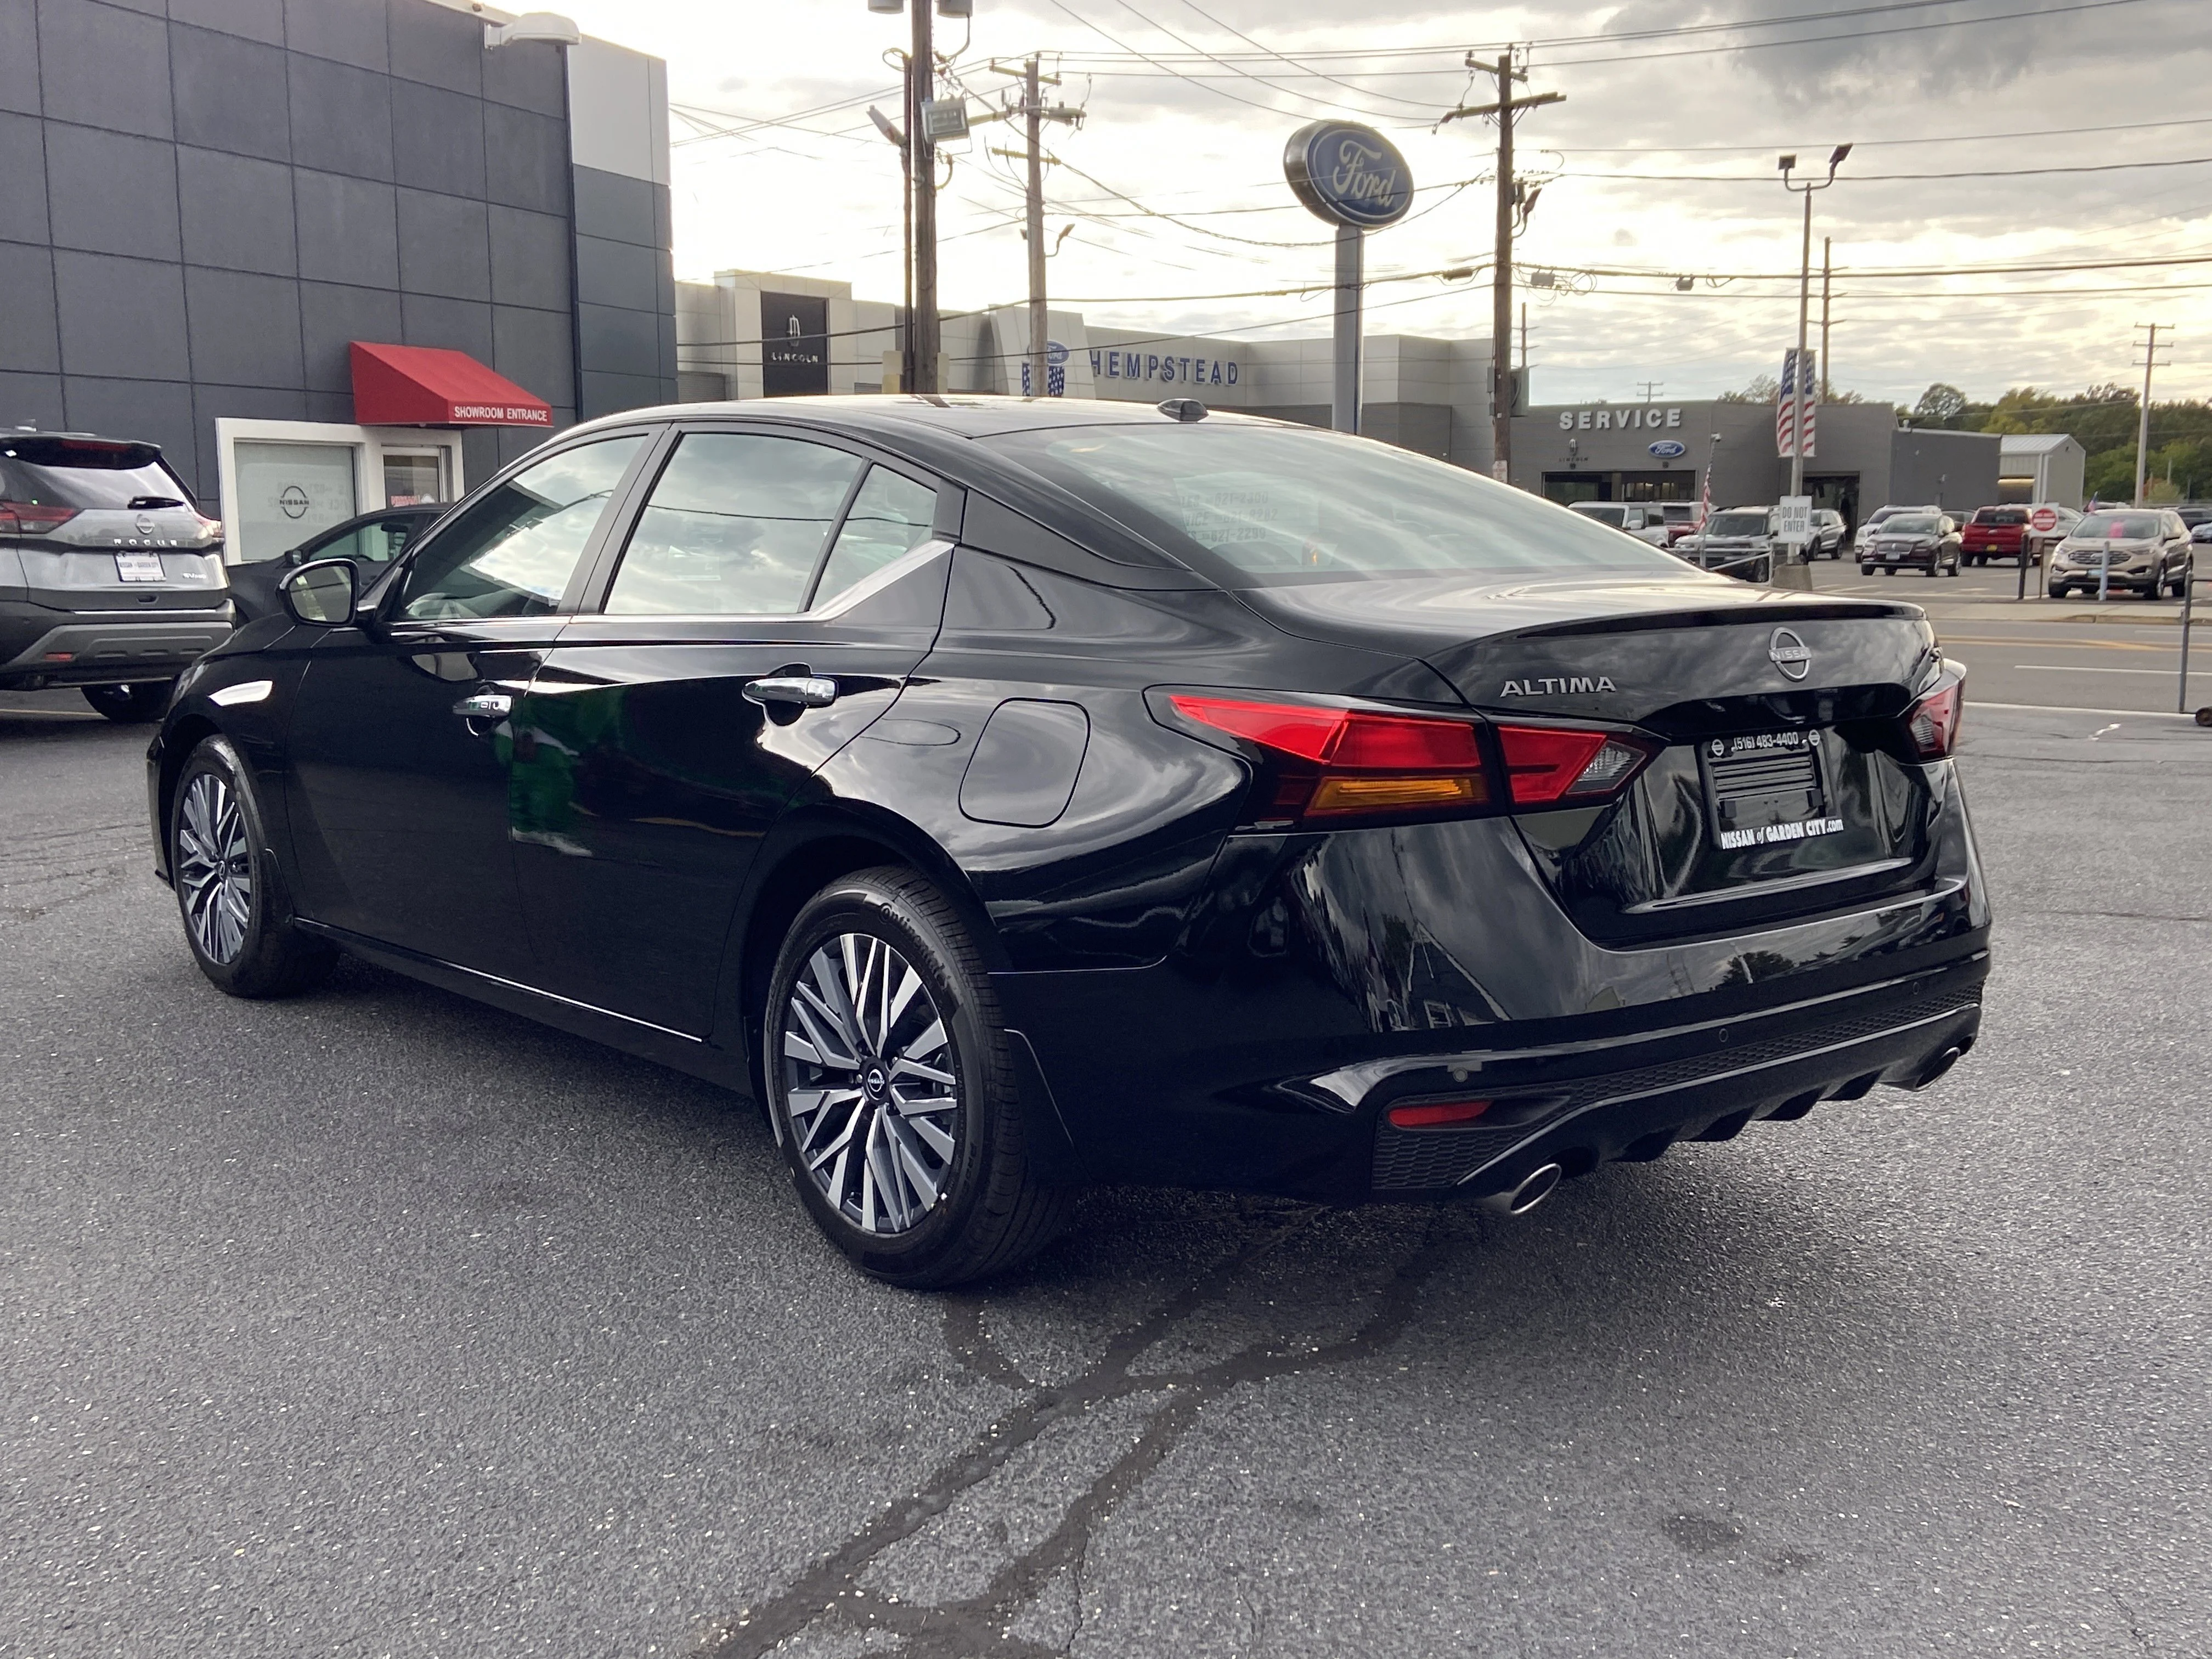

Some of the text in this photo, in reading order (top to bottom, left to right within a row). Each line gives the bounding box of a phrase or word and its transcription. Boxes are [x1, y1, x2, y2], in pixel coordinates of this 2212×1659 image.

[1332, 139, 1396, 207] Ford
[771, 352, 819, 363] LINCOLN
[1090, 349, 1238, 385] HEMPSTEAD
[454, 406, 548, 422] SHOWROOM ENTRANCE
[1559, 408, 1682, 430] SERVICE
[1655, 444, 1678, 454] Ford
[1782, 506, 1808, 518] DO NOT
[1784, 520, 1805, 532] ENTER
[1770, 649, 1810, 661] NISSA
[1499, 676, 1617, 697] ALTIMA
[1734, 736, 1756, 750] (516)
[1756, 732, 1799, 748] 483-4400
[1720, 829, 1756, 850] NISSAN
[1756, 827, 1765, 844] of
[1765, 822, 1804, 842] GARDEN
